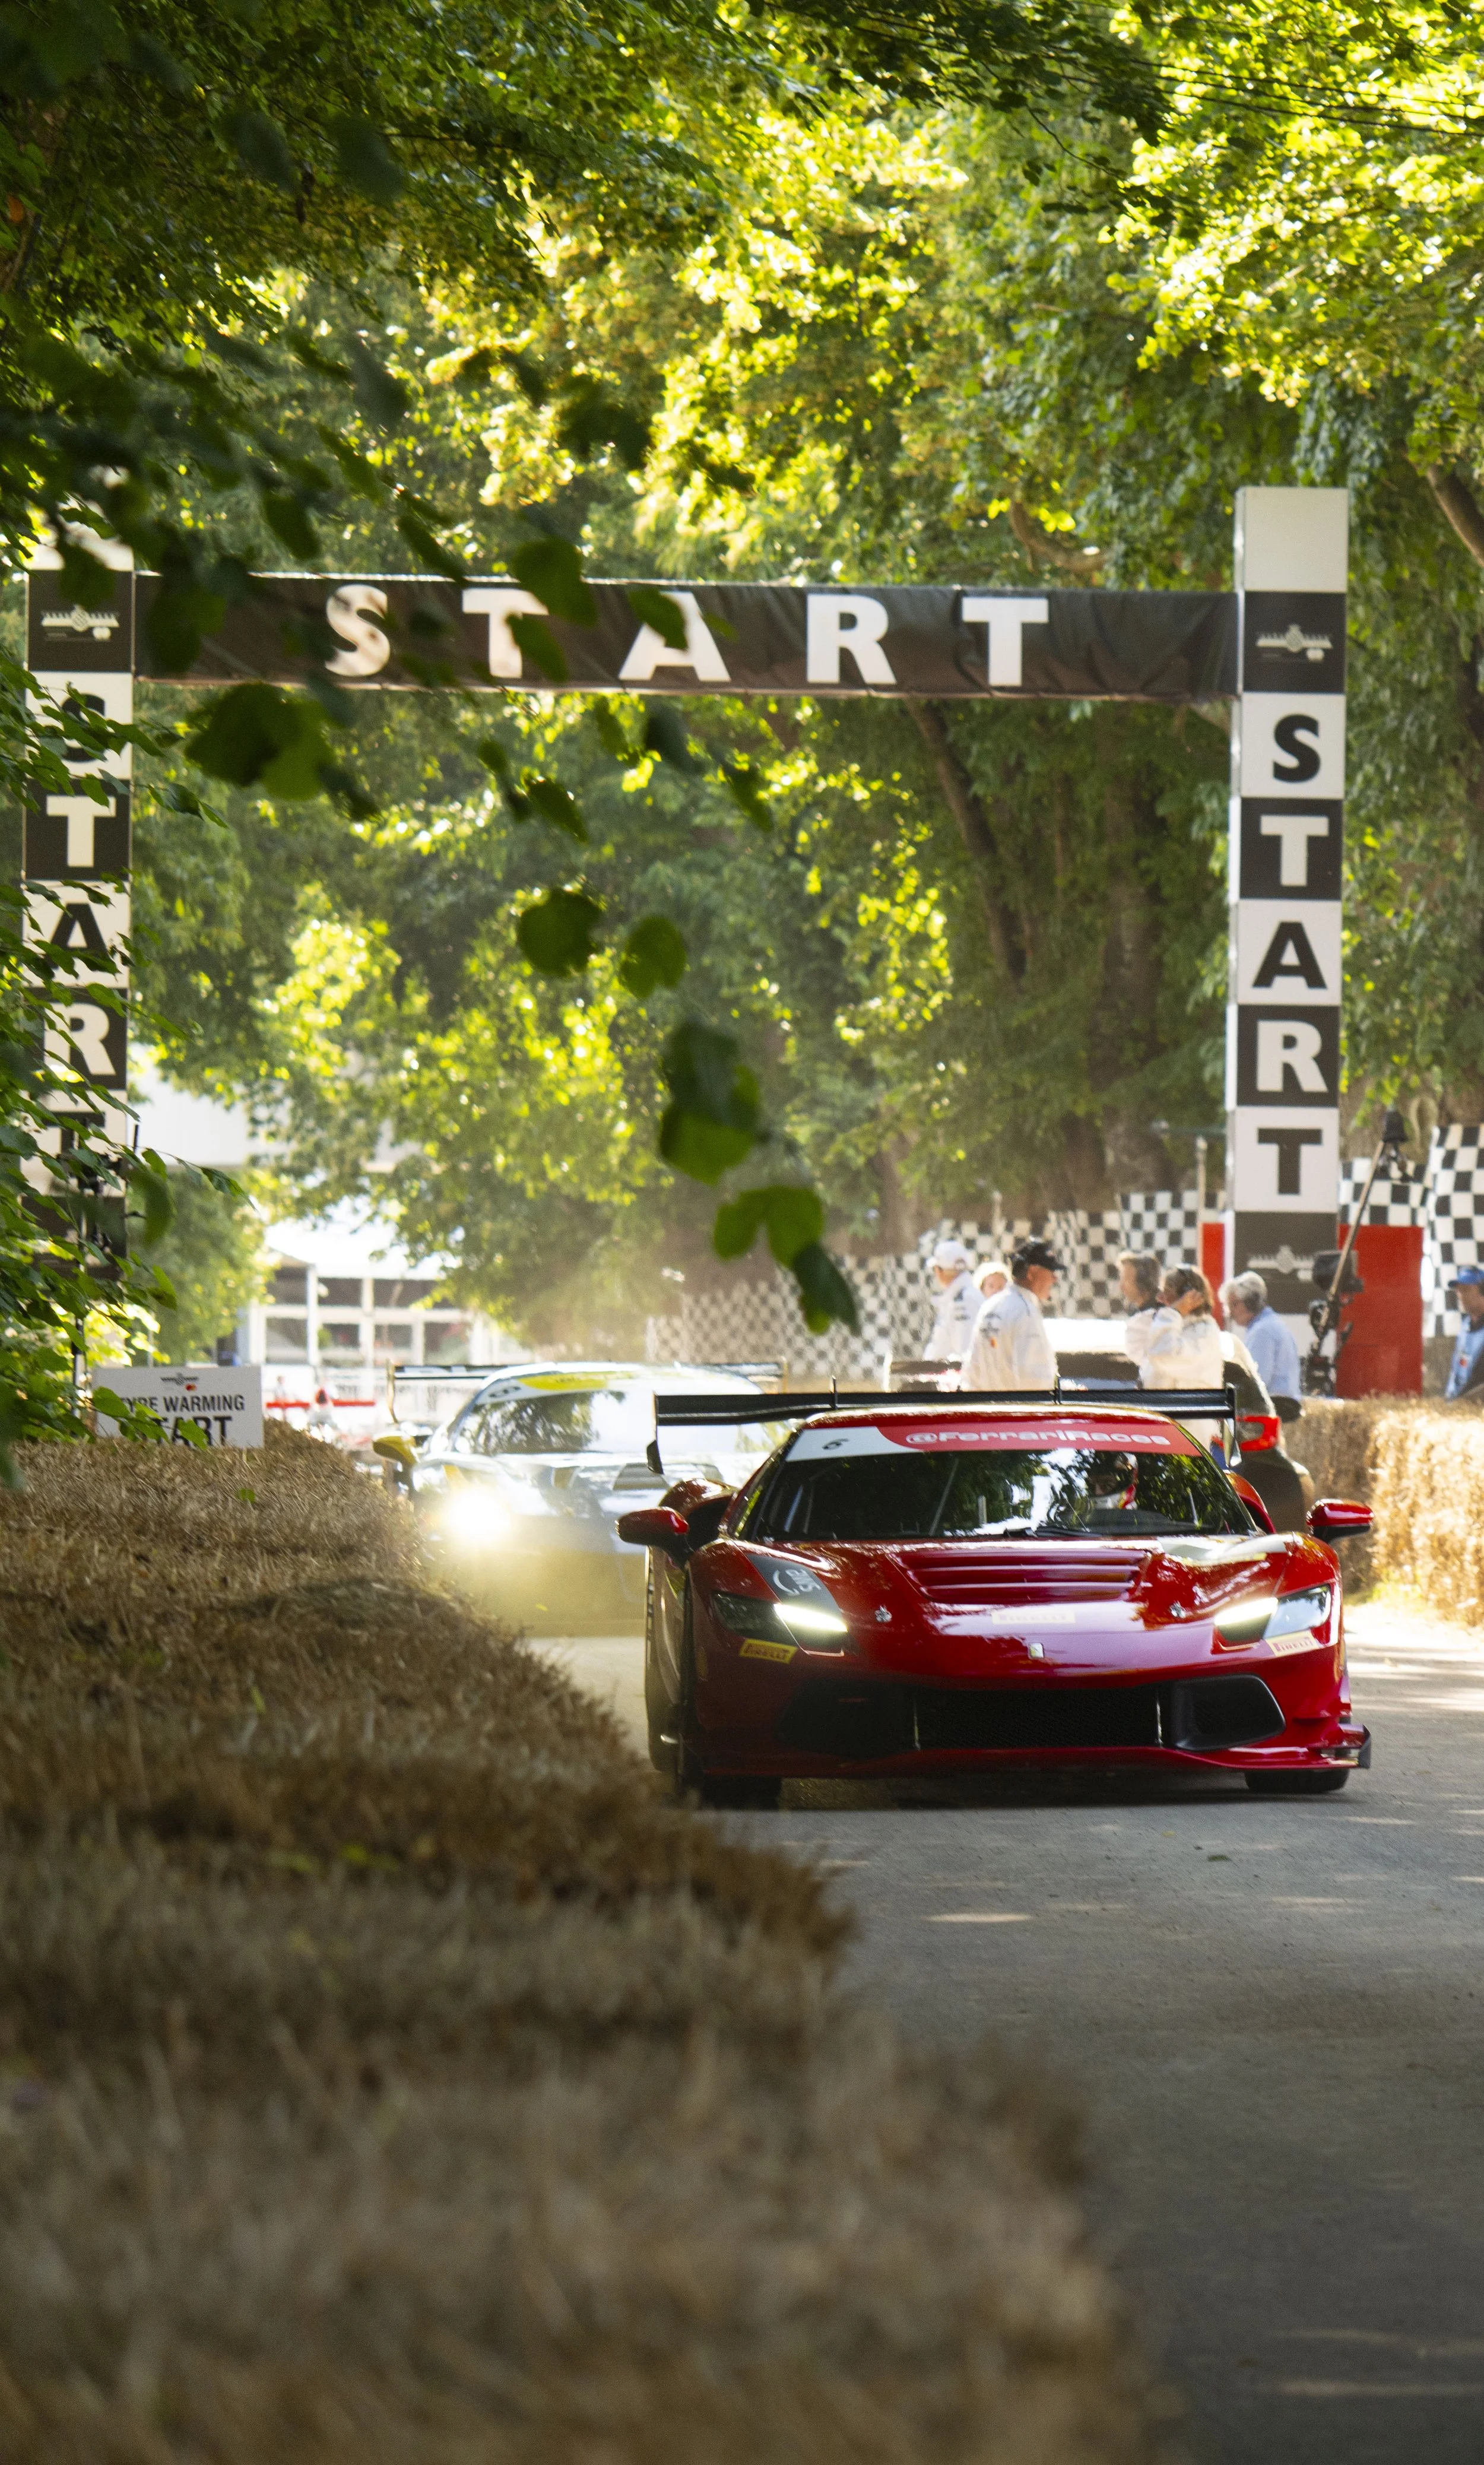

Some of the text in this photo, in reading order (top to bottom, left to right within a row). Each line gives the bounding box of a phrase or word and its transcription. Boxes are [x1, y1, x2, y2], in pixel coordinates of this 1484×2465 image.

[325, 585, 1049, 686] START
[1252, 714, 1329, 1195] START
[163, 1394, 245, 1413] WARMING
[906, 1429, 1171, 1446] @FerrariRaces
